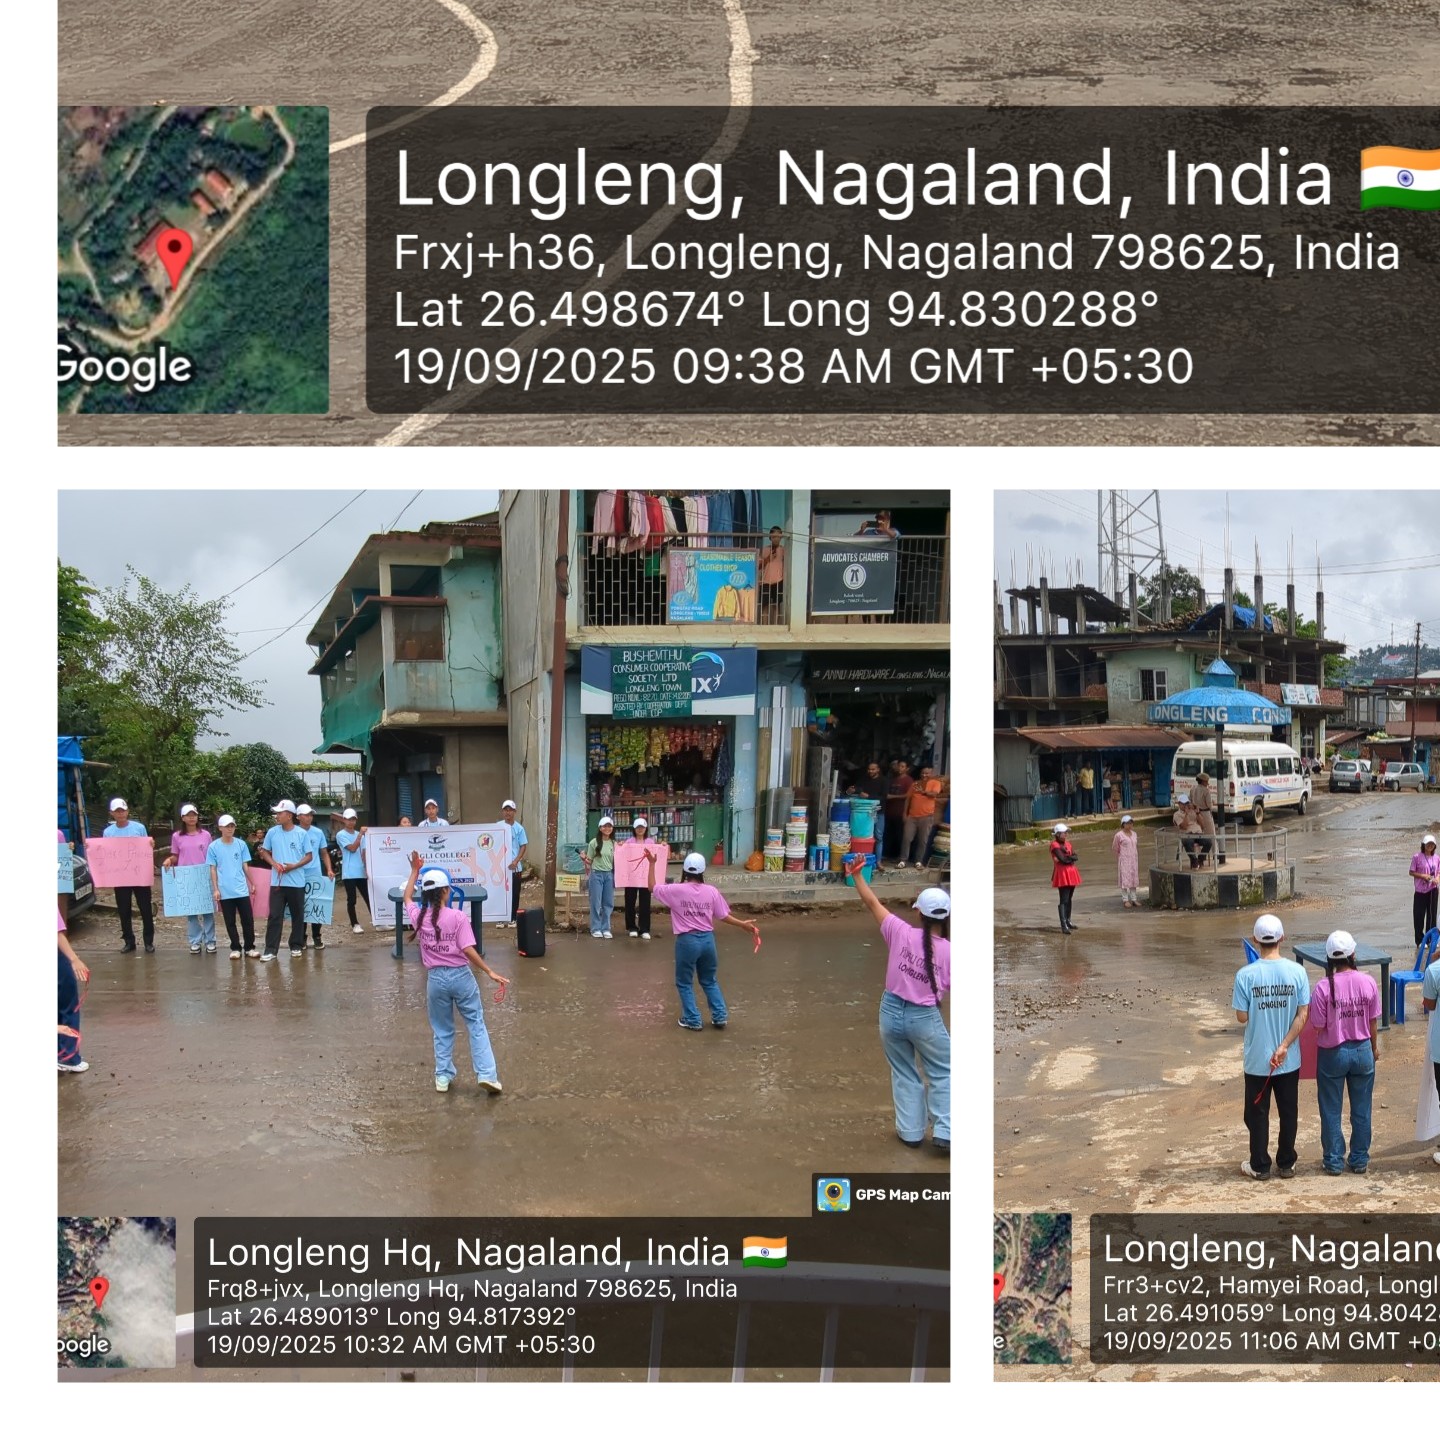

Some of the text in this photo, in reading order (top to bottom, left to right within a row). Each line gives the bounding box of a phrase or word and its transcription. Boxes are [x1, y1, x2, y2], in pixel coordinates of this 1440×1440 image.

[822, 552, 889, 563] ADVOCATES CHAMBER
[623, 649, 683, 662] BUSHEMTHU
[612, 661, 692, 674] CONSUMER COOPERATIVE
[628, 673, 678, 684] SOCIETY LTD
[625, 683, 682, 694] LONGLENG TOWN
[1270, 984, 1296, 997] COLLEGE
